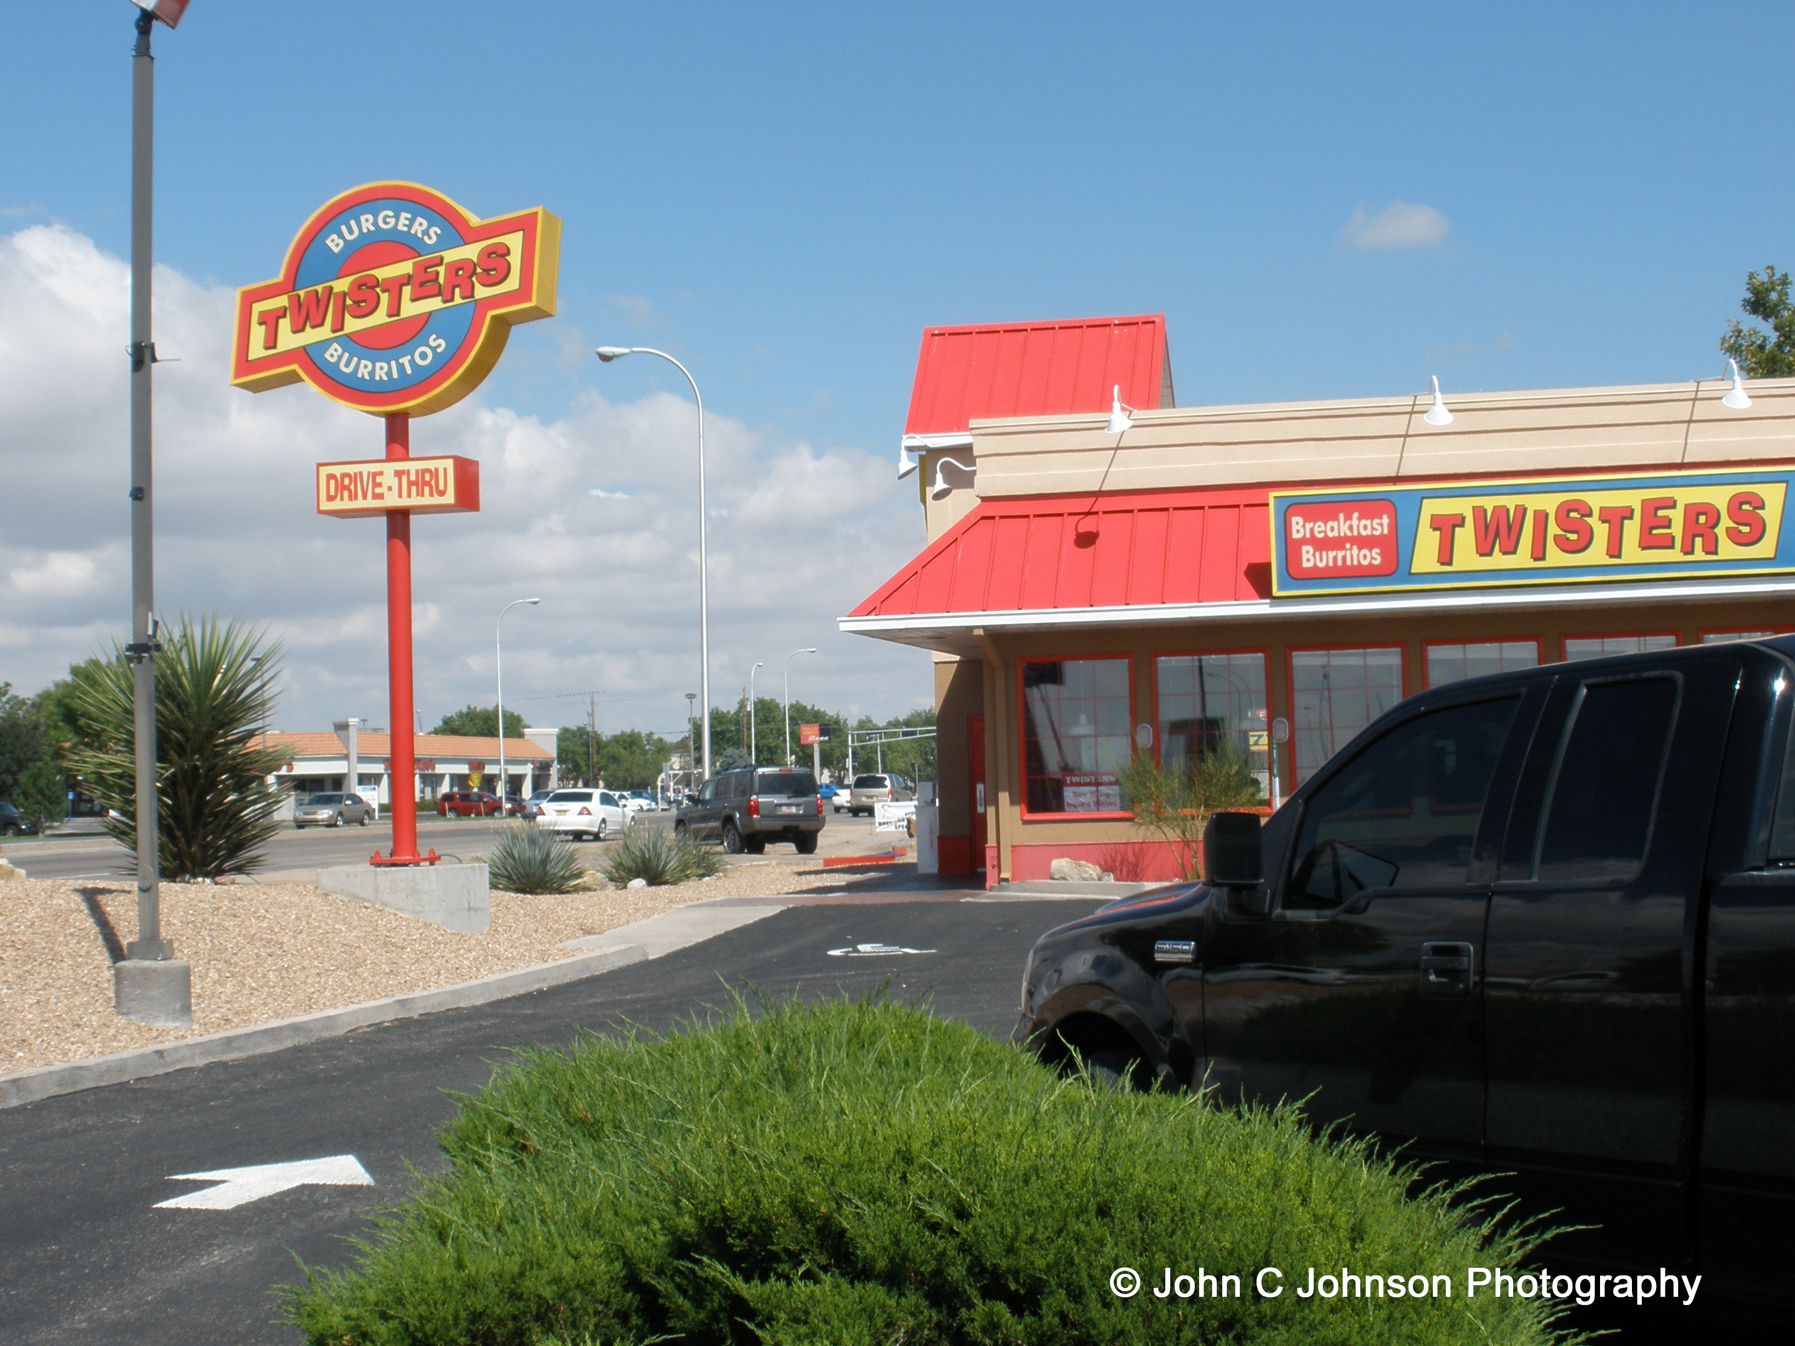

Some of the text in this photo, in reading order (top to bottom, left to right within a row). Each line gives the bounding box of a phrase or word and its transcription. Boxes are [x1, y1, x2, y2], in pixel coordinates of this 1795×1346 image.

[324, 209, 442, 254] BURGERS
[257, 242, 512, 350] TWISTERS
[323, 333, 446, 381] BURRITOS
[325, 467, 447, 502] DRIVE-THRU
[1291, 512, 1389, 539] Breakfast
[1430, 491, 1765, 566] TWISTERS
[1301, 543, 1381, 568] Burritos
